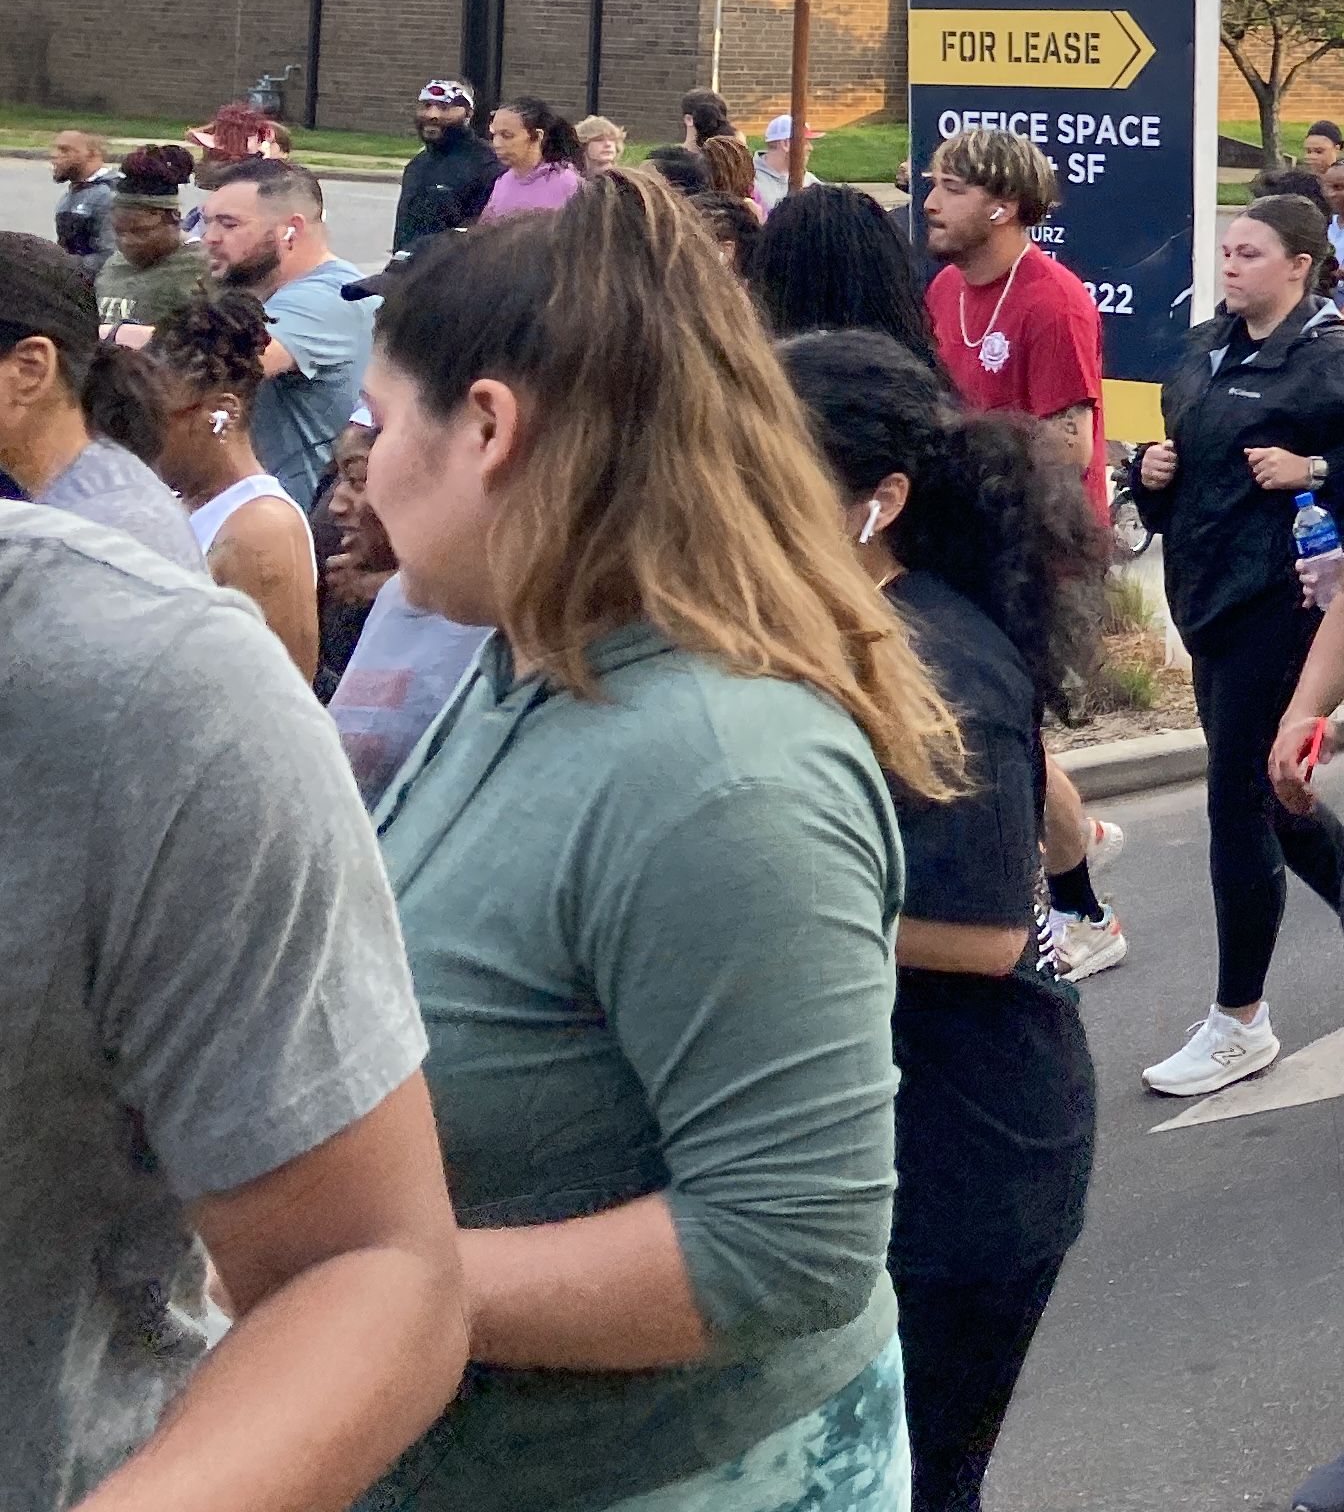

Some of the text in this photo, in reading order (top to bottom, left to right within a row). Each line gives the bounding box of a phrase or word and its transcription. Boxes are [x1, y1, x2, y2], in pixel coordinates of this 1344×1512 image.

[942, 31, 1101, 64] FOR LEASE
[938, 110, 1161, 147] OFFICE SPACE
[1067, 153, 1106, 184] SF
[1029, 226, 1065, 244] URZ
